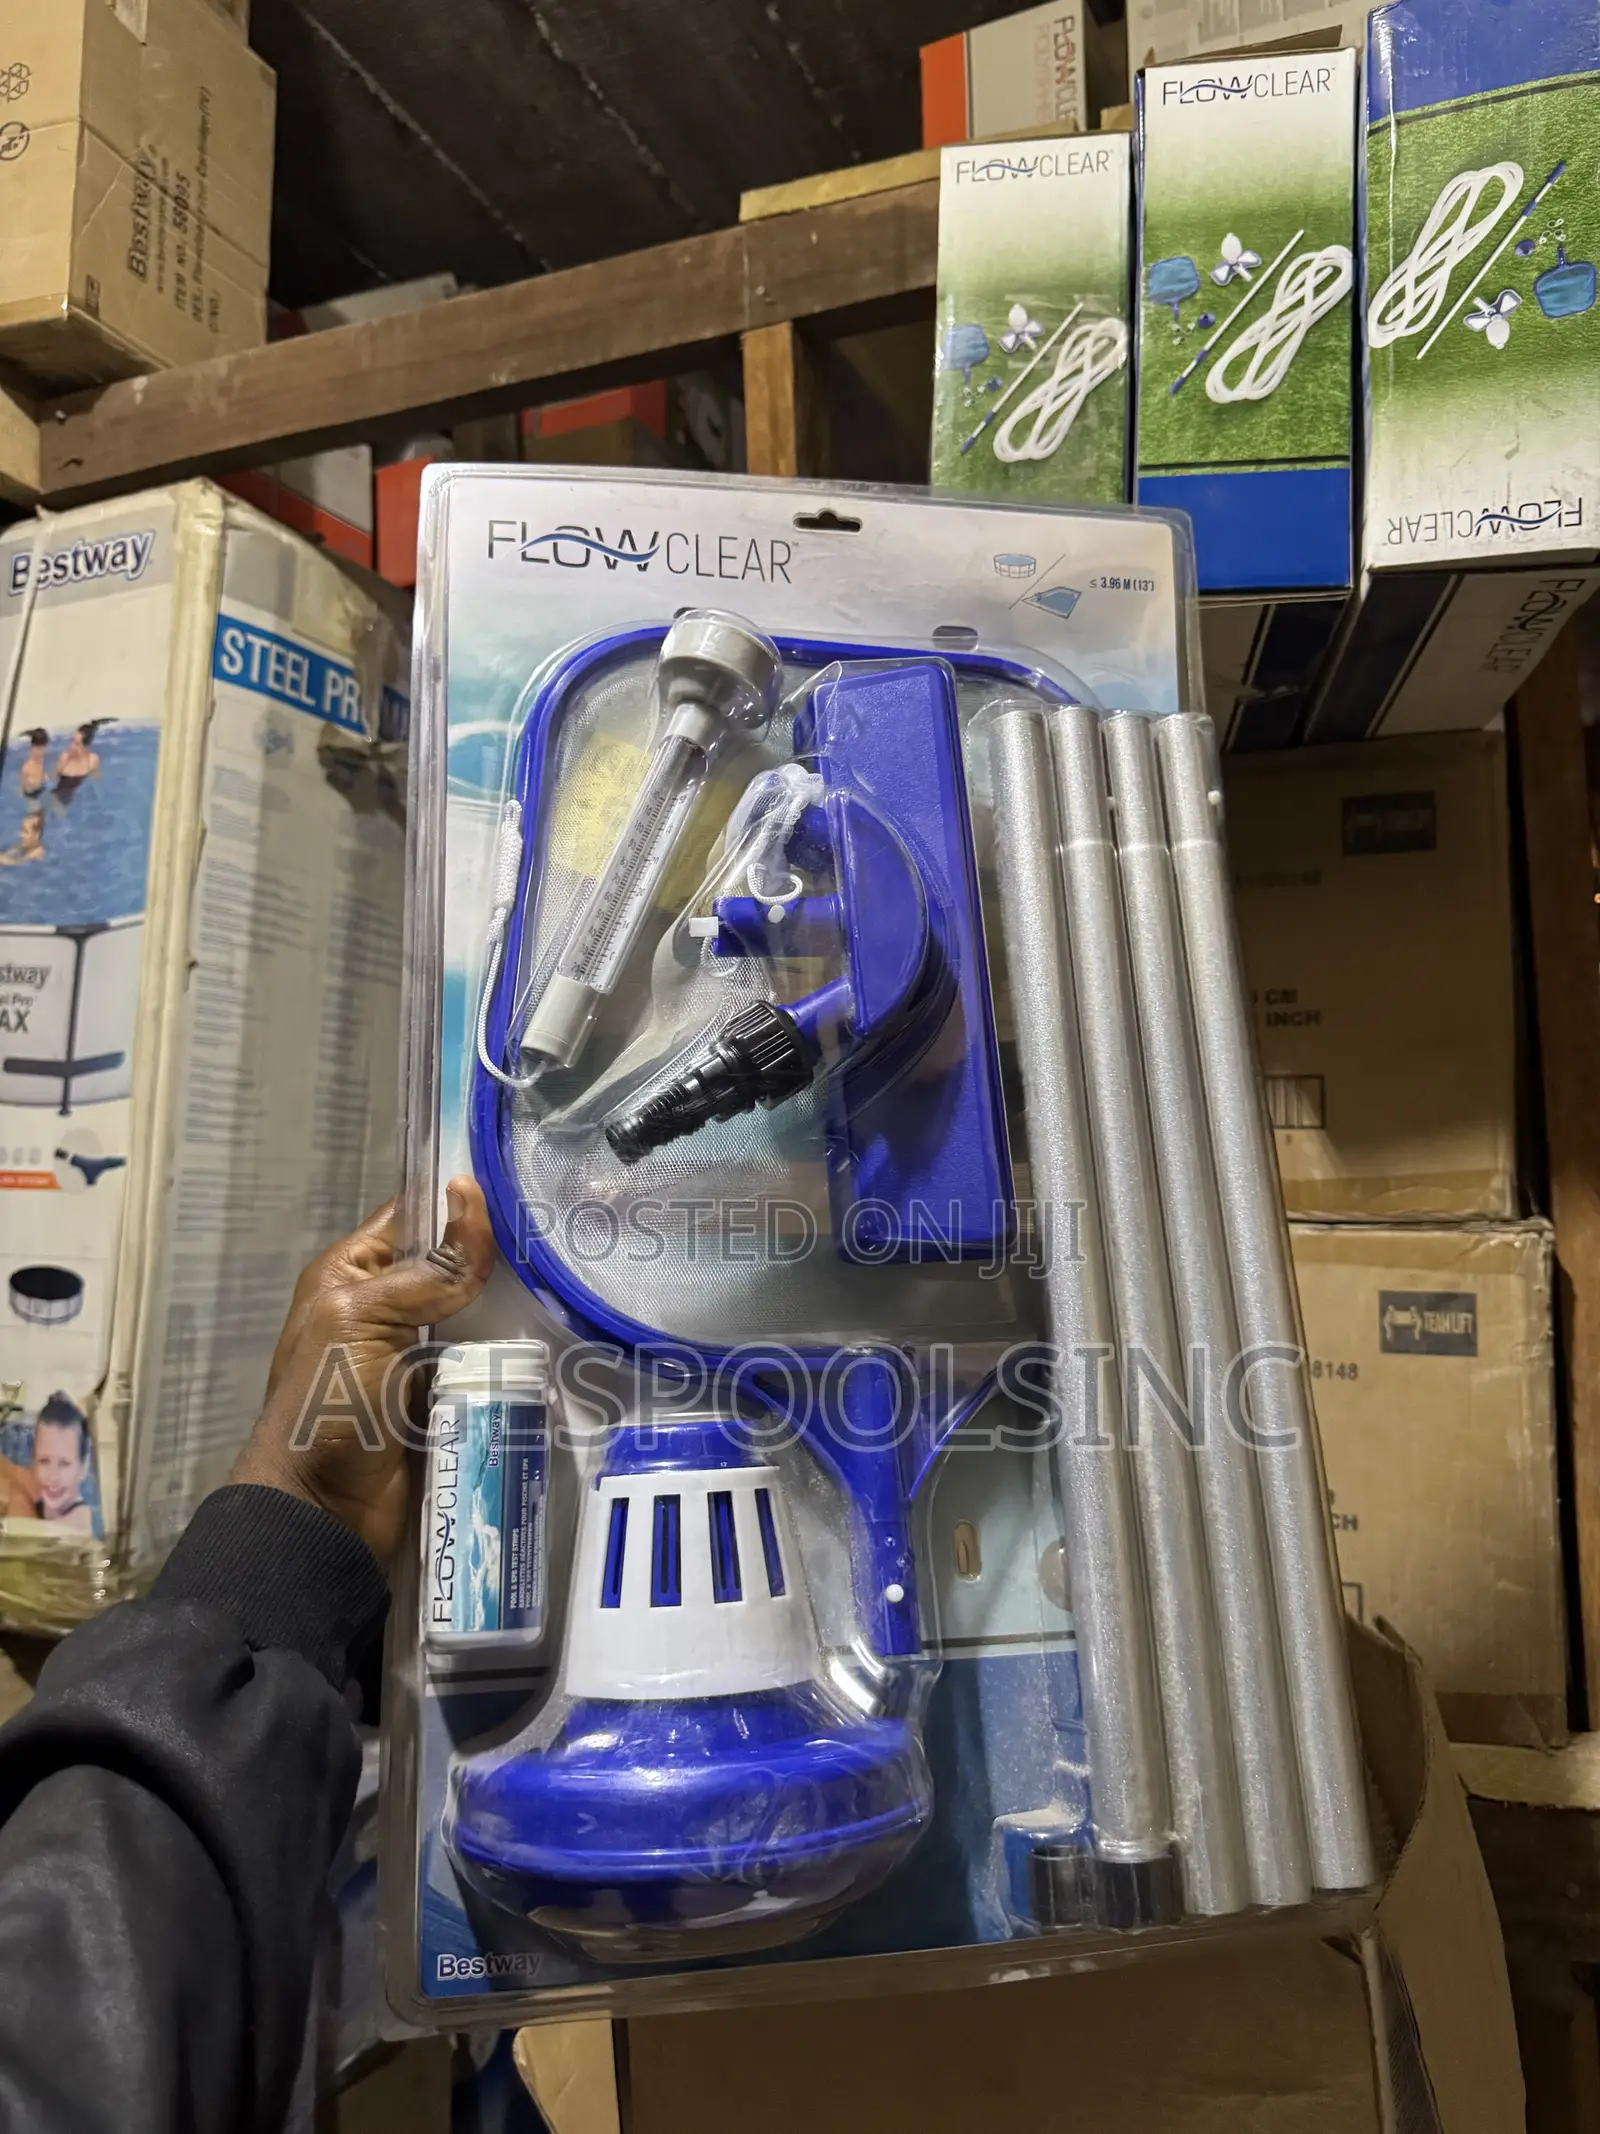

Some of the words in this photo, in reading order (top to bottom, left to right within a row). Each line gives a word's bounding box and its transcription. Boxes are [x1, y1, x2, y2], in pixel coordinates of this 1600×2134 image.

[1054, 15, 1078, 121] FLOWCLE
[1162, 69, 1332, 106] FLOWCLEAR
[956, 150, 1111, 184] FLOWCLEAR
[1387, 496, 1583, 546] FLOWCLEAR
[10, 529, 155, 596] Bestway
[488, 518, 793, 585] FLOWCLEAR
[1100, 577, 1121, 590] 3.96
[1123, 578, 1131, 590] M
[220, 628, 316, 706] STEEL
[322, 668, 364, 726] PR
[0, 963, 54, 992] stway
[0, 1008, 30, 1034] AX
[1266, 1009, 1322, 1028] INCH
[1423, 1311, 1450, 1333] TEAM
[1311, 1360, 1359, 1381] 8148
[487, 1411, 500, 1467] Bestway
[433, 1419, 461, 1624] FLOWCLEAR
[1331, 1512, 1359, 1532] CH
[437, 1953, 541, 1981] Bestway
